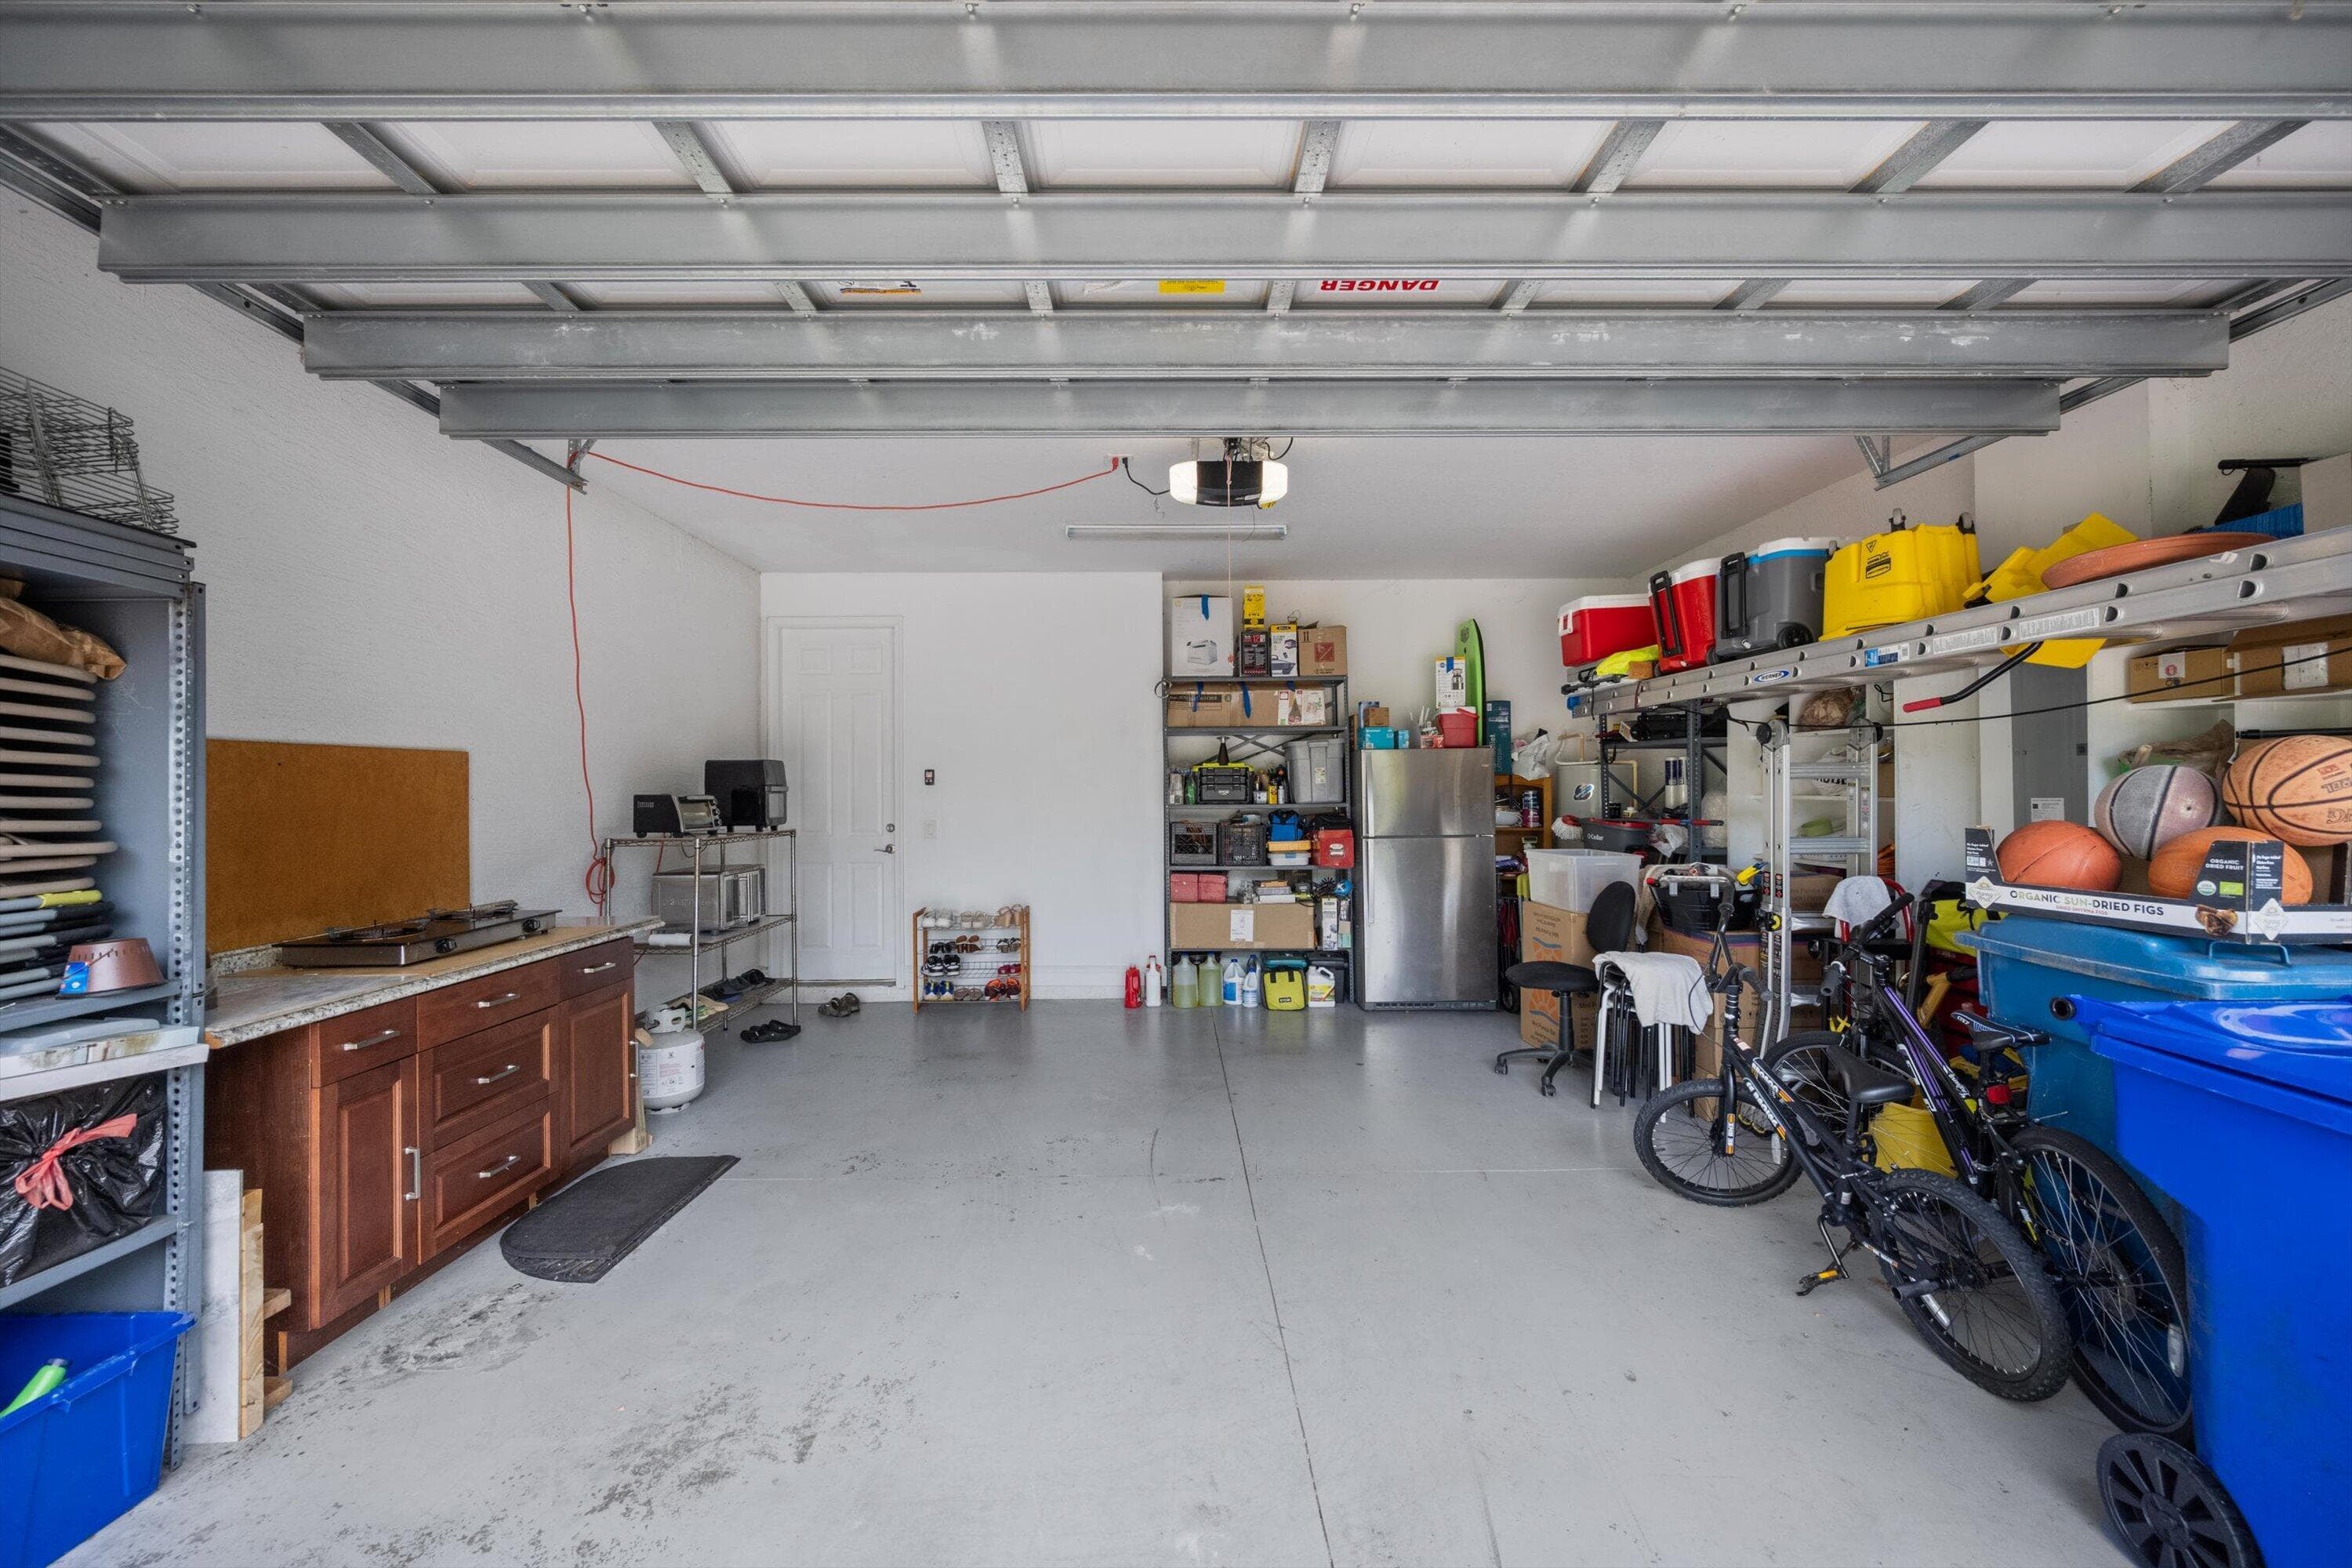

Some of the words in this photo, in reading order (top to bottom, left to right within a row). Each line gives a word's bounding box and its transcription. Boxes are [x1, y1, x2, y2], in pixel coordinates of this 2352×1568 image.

[1320, 280, 1439, 292] DANGER
[2009, 890, 2061, 904] ORGANIC
[2064, 895, 2130, 914] SUN-DRIED
[2134, 902, 2165, 916] FIGS
